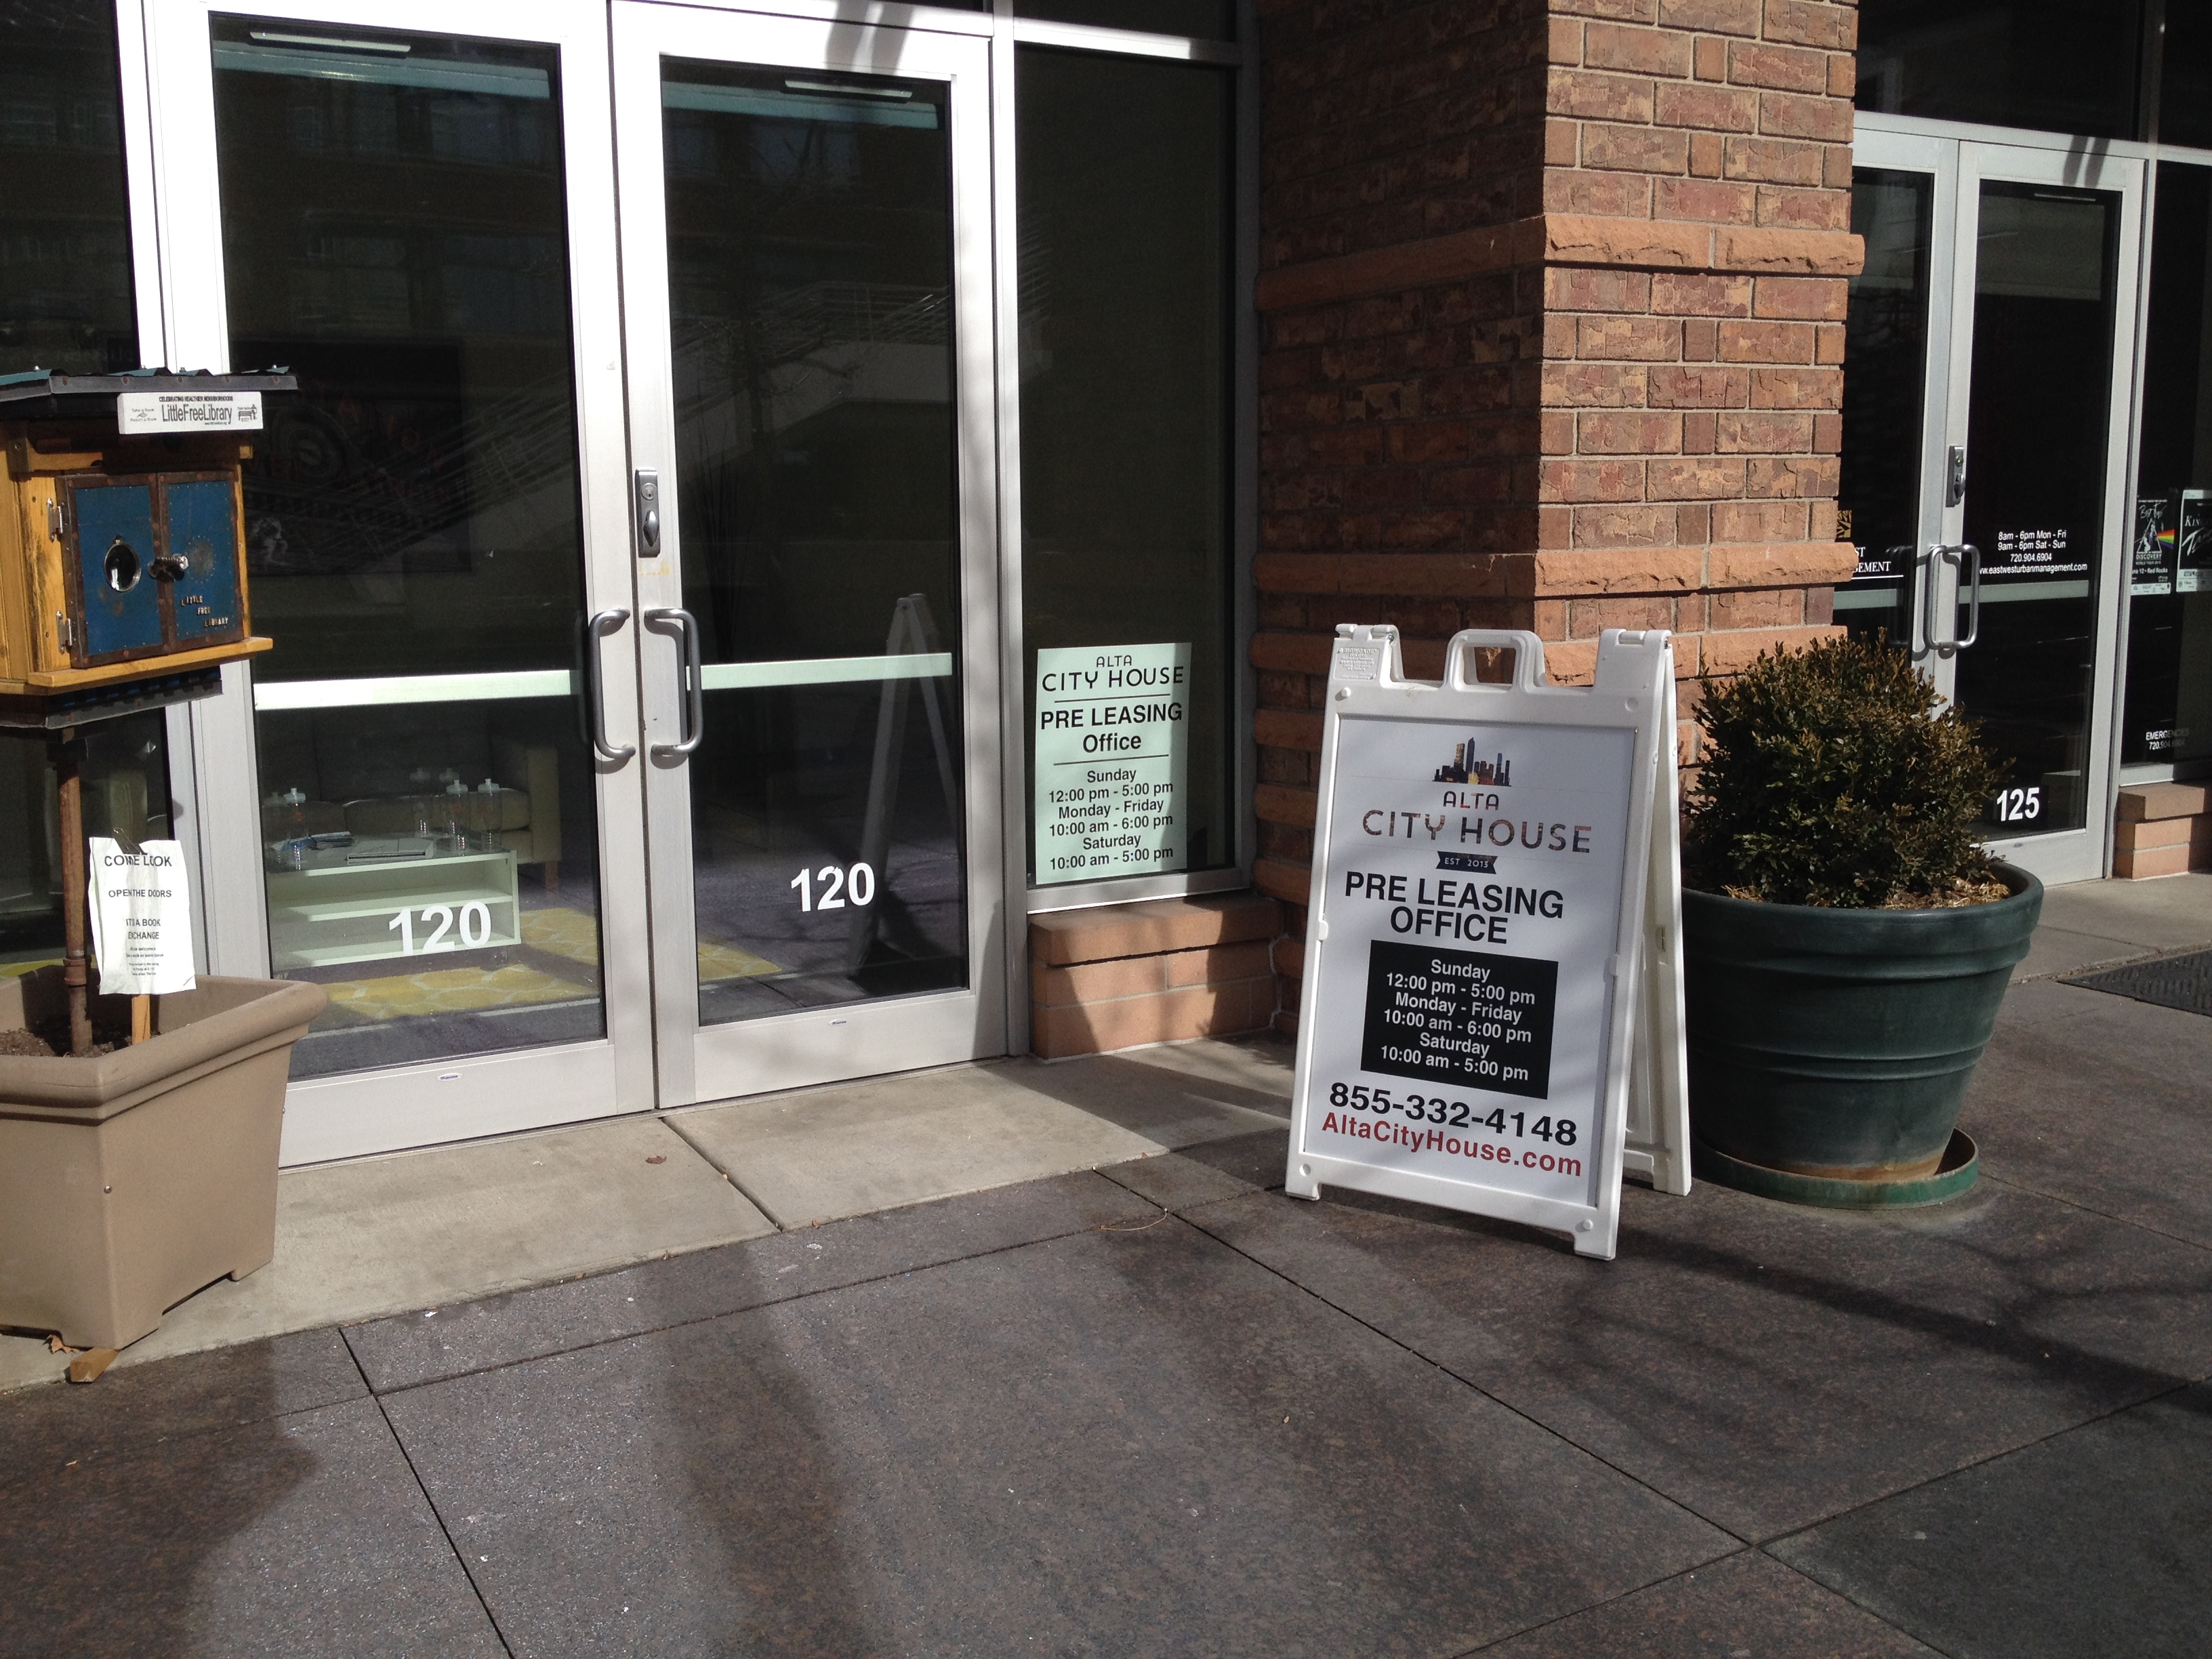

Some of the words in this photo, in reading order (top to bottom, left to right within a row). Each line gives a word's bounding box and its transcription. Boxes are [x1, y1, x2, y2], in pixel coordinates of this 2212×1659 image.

[162, 404, 232, 424] LittleFreeLibrary
[1998, 541, 2013, 550] 9am
[2019, 541, 2033, 551] 6pm
[2035, 540, 2047, 549] Sat
[2052, 539, 2066, 548] Sun
[1999, 531, 2013, 540] 8am
[2020, 531, 2034, 541] 6pm
[2036, 530, 2051, 539] Mon
[2057, 529, 2066, 539] Fri
[2010, 553, 2052, 562] 720.904.6904
[181, 595, 203, 606] LITTLE
[198, 606, 211, 615] FREE
[205, 617, 228, 627] LIBRARY
[1096, 655, 1132, 668] ALTA
[1042, 671, 1098, 692] CITY
[1109, 666, 1184, 688] HOUSE
[1041, 709, 1084, 730] PRE
[1091, 702, 1182, 726] LEASING
[1083, 733, 1141, 753] Office
[1087, 768, 1136, 783] Sunday
[1049, 788, 1084, 803] 12:00
[1089, 788, 1109, 802] pm
[1122, 783, 1149, 797] 5:00
[1153, 783, 1173, 797] pm
[1443, 791, 1499, 811] ALTA
[1059, 804, 1111, 819] Monday
[1124, 798, 1164, 813] Friday
[1996, 787, 2039, 822] 125
[1050, 821, 1085, 836] 10:00
[1089, 821, 1109, 833] am
[1122, 815, 1149, 830] 6:00
[1153, 815, 1173, 830] pm
[1362, 809, 1446, 840] CITY
[1460, 817, 1592, 853] HOUSE
[1083, 834, 1141, 850] Saturday
[104, 855, 140, 866] COME
[144, 855, 172, 866] LOOK
[1050, 855, 1085, 870] 10:00
[1090, 855, 1109, 866] am
[1122, 848, 1149, 863] 5:00
[1153, 848, 1173, 862] pm
[1444, 857, 1460, 865] EST
[1467, 859, 1489, 868] 2013
[108, 889, 132, 897] OPEN
[148, 889, 172, 897] DOORS
[790, 863, 875, 912] 120
[1345, 871, 1407, 902] PRE
[1418, 878, 1563, 919] LEASING
[136, 918, 140, 926] A
[142, 918, 161, 926] BOOK
[388, 901, 492, 956] 120
[1391, 906, 1508, 944] OFFICE
[1431, 959, 1490, 983] Sunday
[1387, 972, 1427, 990] 12:00
[1431, 981, 1456, 995] pm
[1471, 983, 1505, 1001] 5:00
[1509, 990, 1535, 1005] pm
[1395, 991, 1456, 1016] Monday
[1472, 1002, 1522, 1025] Friday
[1384, 1008, 1425, 1027] 10:00
[1429, 1019, 1452, 1031] am
[1467, 1020, 1501, 1038] 6:00
[1506, 1028, 1532, 1043] pm
[1420, 1032, 1490, 1059] Saturday
[1381, 1045, 1421, 1064] 10:00
[1425, 1054, 1449, 1069] am
[1464, 1058, 1498, 1076] 5:00
[1503, 1066, 1528, 1081] pm
[1330, 1082, 1577, 1146] 855-332-4148
[1322, 1111, 1580, 1176] AltaCityHouse.com
